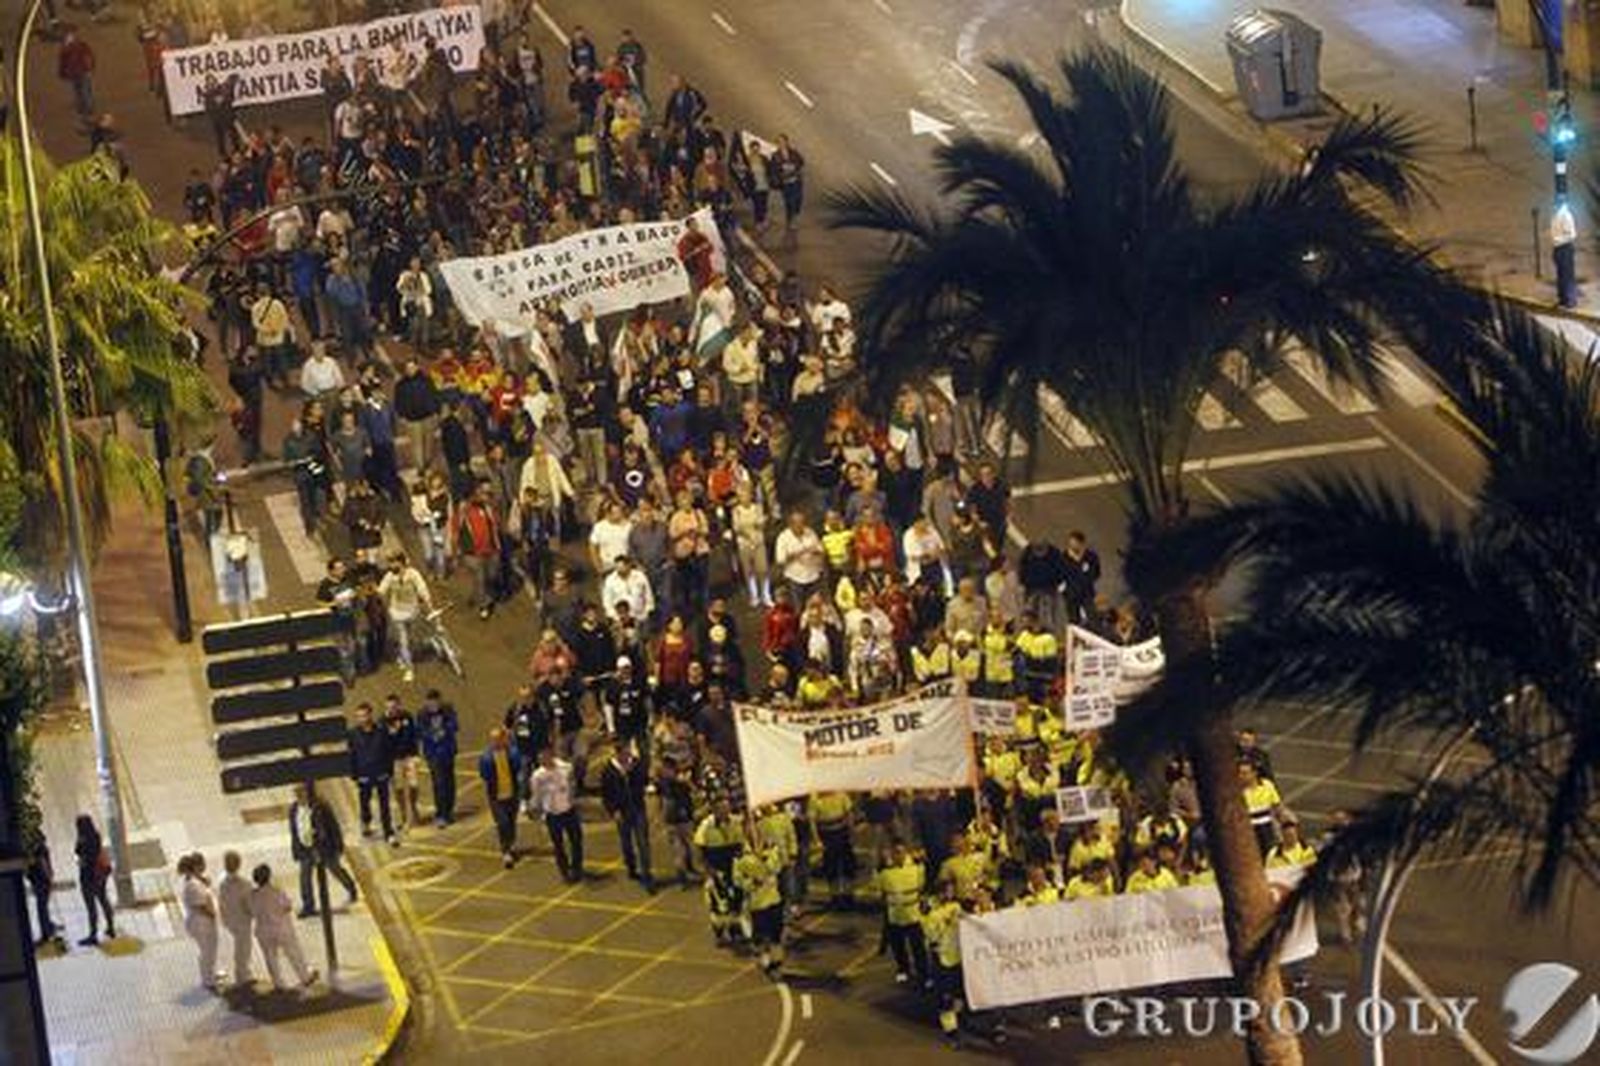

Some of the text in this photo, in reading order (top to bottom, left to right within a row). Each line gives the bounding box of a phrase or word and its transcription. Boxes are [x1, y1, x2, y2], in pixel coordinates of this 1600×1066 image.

[174, 44, 271, 78] TRABAJO
[276, 36, 330, 63] PARA
[335, 33, 362, 55] LA
[367, 18, 428, 50] BAHÍA
[435, 9, 473, 41] ¡YA!
[581, 224, 680, 250] TRABAJO
[527, 268, 573, 292] PARA
[582, 250, 637, 274] CADIZ
[803, 716, 881, 747] MOTOR
[889, 711, 923, 733] DE
